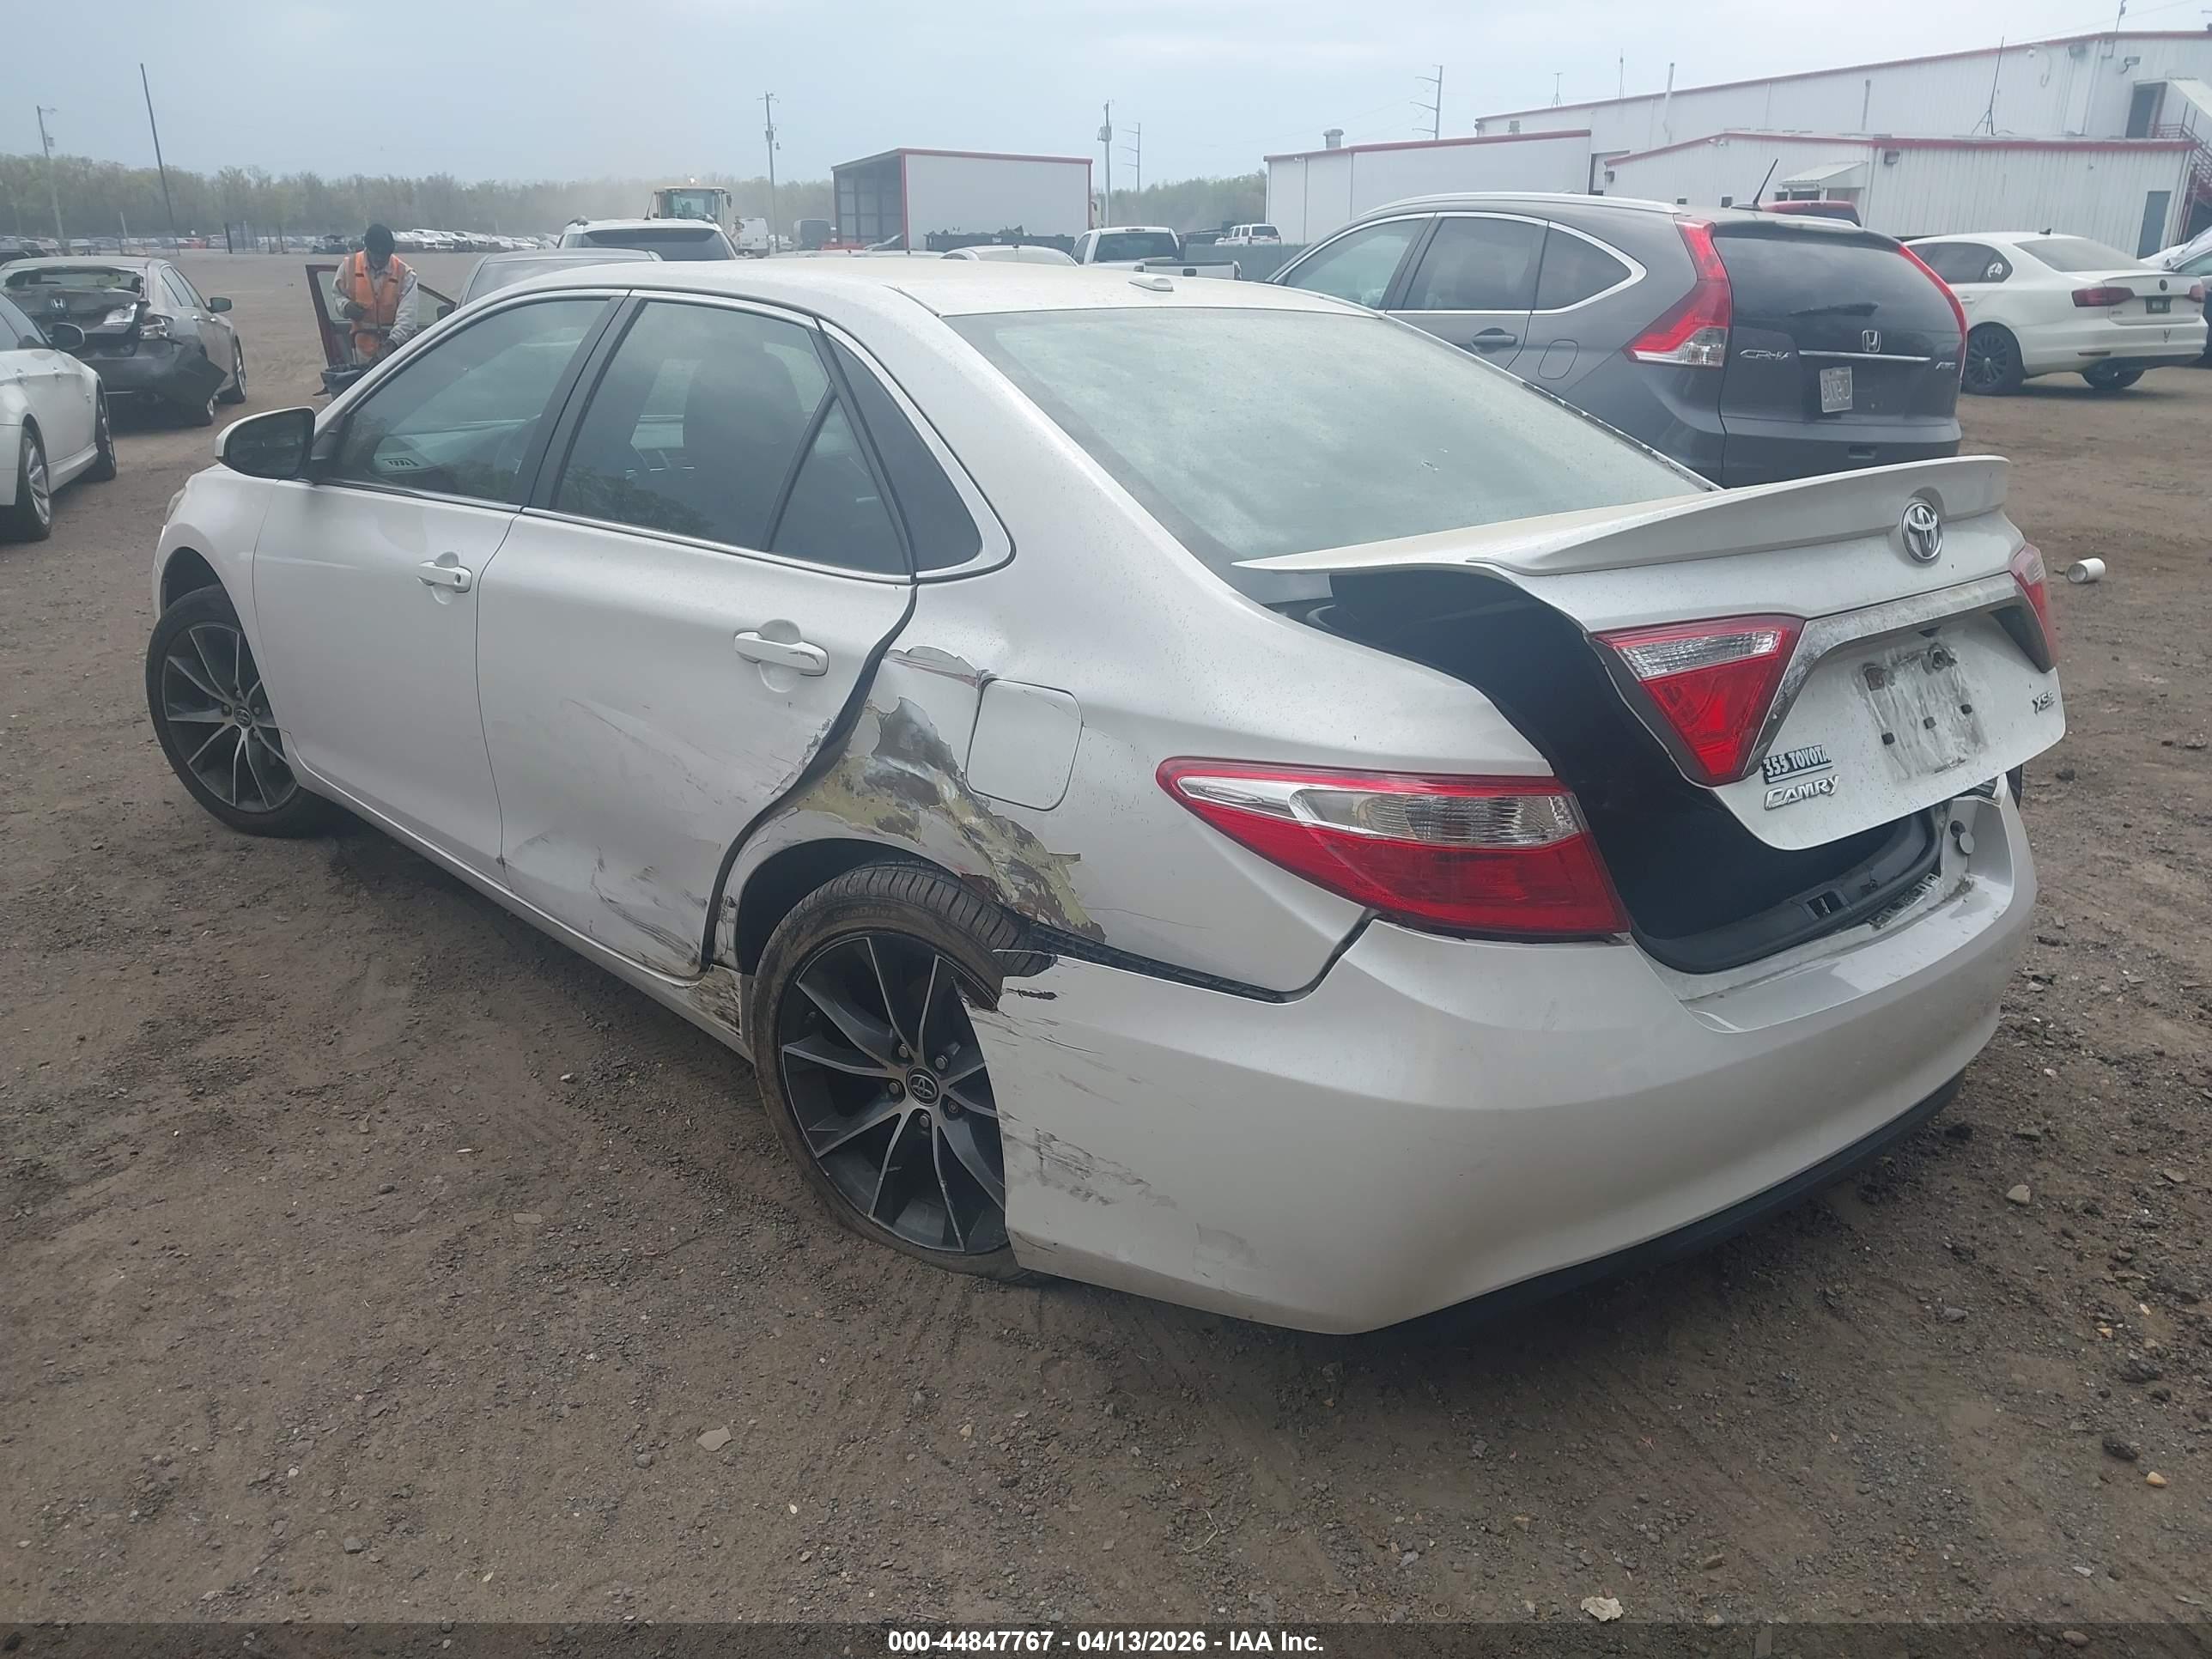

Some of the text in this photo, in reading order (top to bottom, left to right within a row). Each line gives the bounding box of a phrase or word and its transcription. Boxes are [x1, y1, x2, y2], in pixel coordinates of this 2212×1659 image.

[1763, 744, 1832, 777] 355 TOYOTA
[1765, 775, 1839, 811] CAMRY
